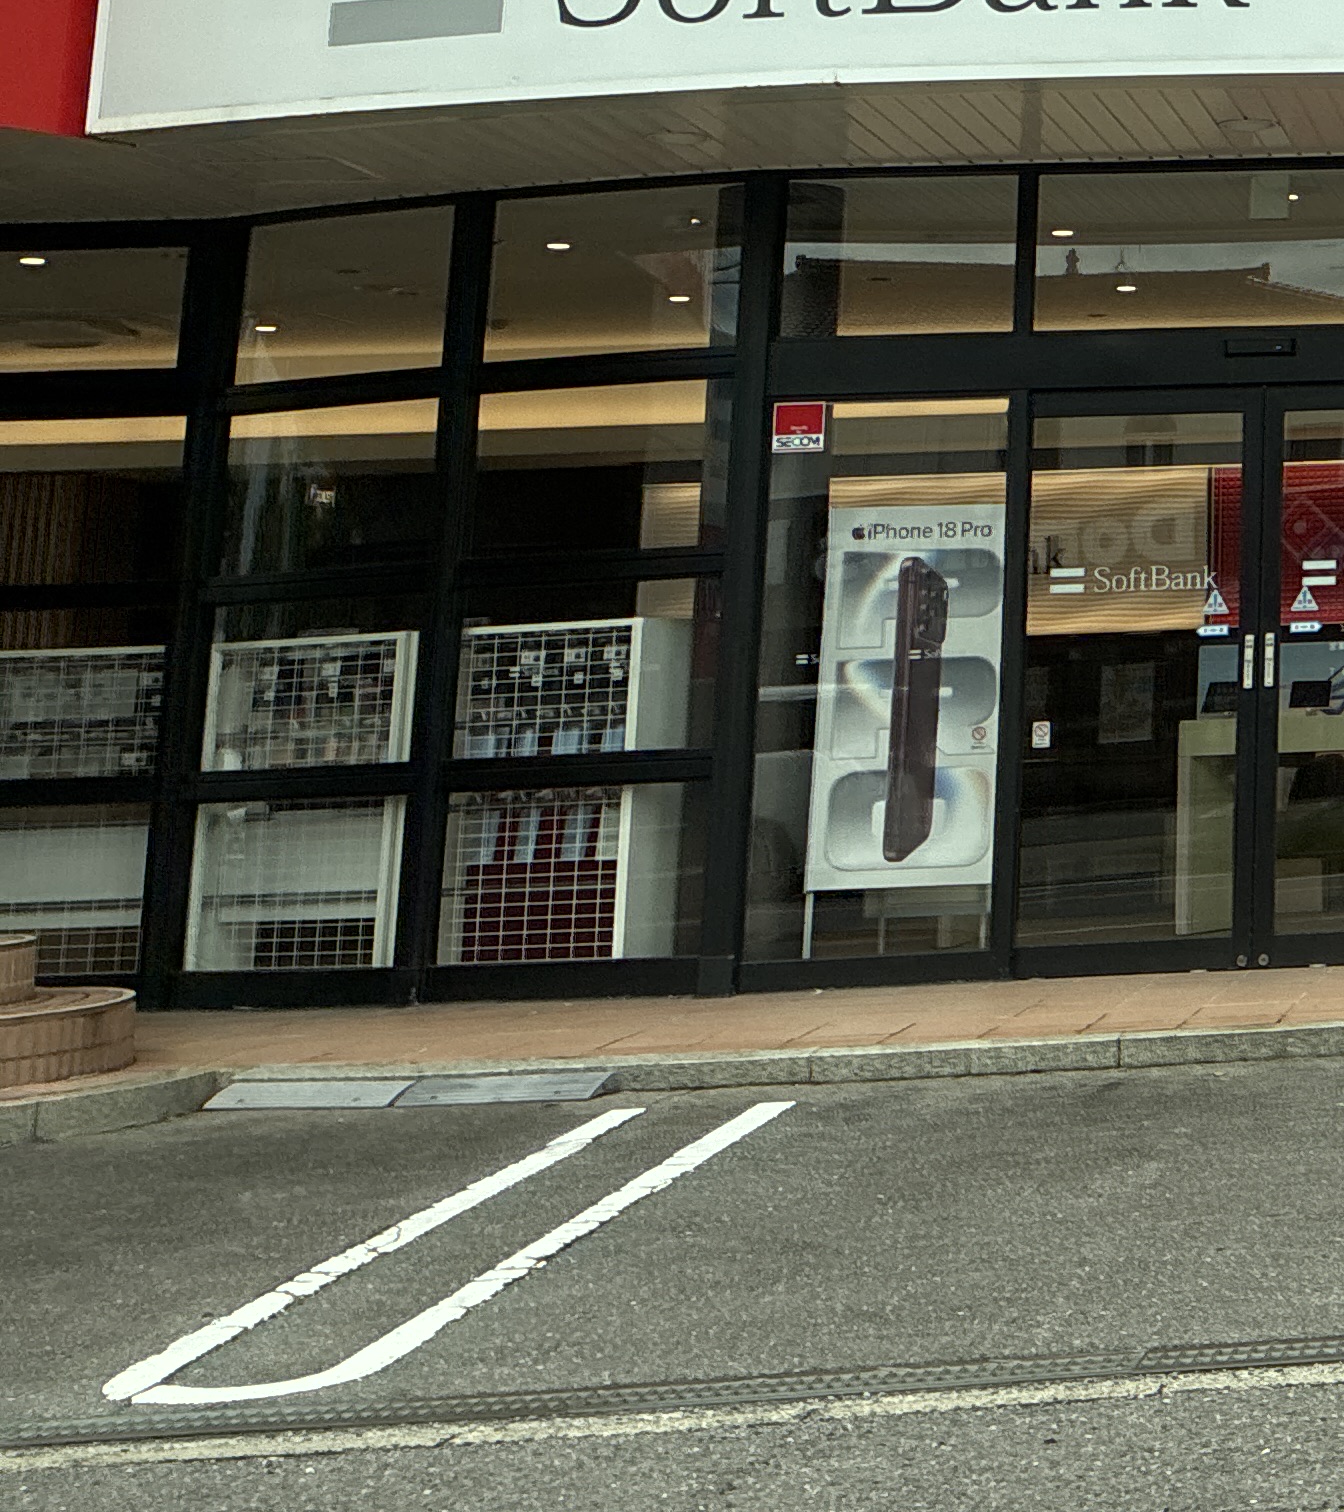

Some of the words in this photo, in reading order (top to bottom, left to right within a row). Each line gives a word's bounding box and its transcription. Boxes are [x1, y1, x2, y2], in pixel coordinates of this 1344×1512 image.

[867, 522, 934, 540] iPhone
[961, 521, 994, 538] Pro
[1093, 564, 1218, 593] SoftBank
